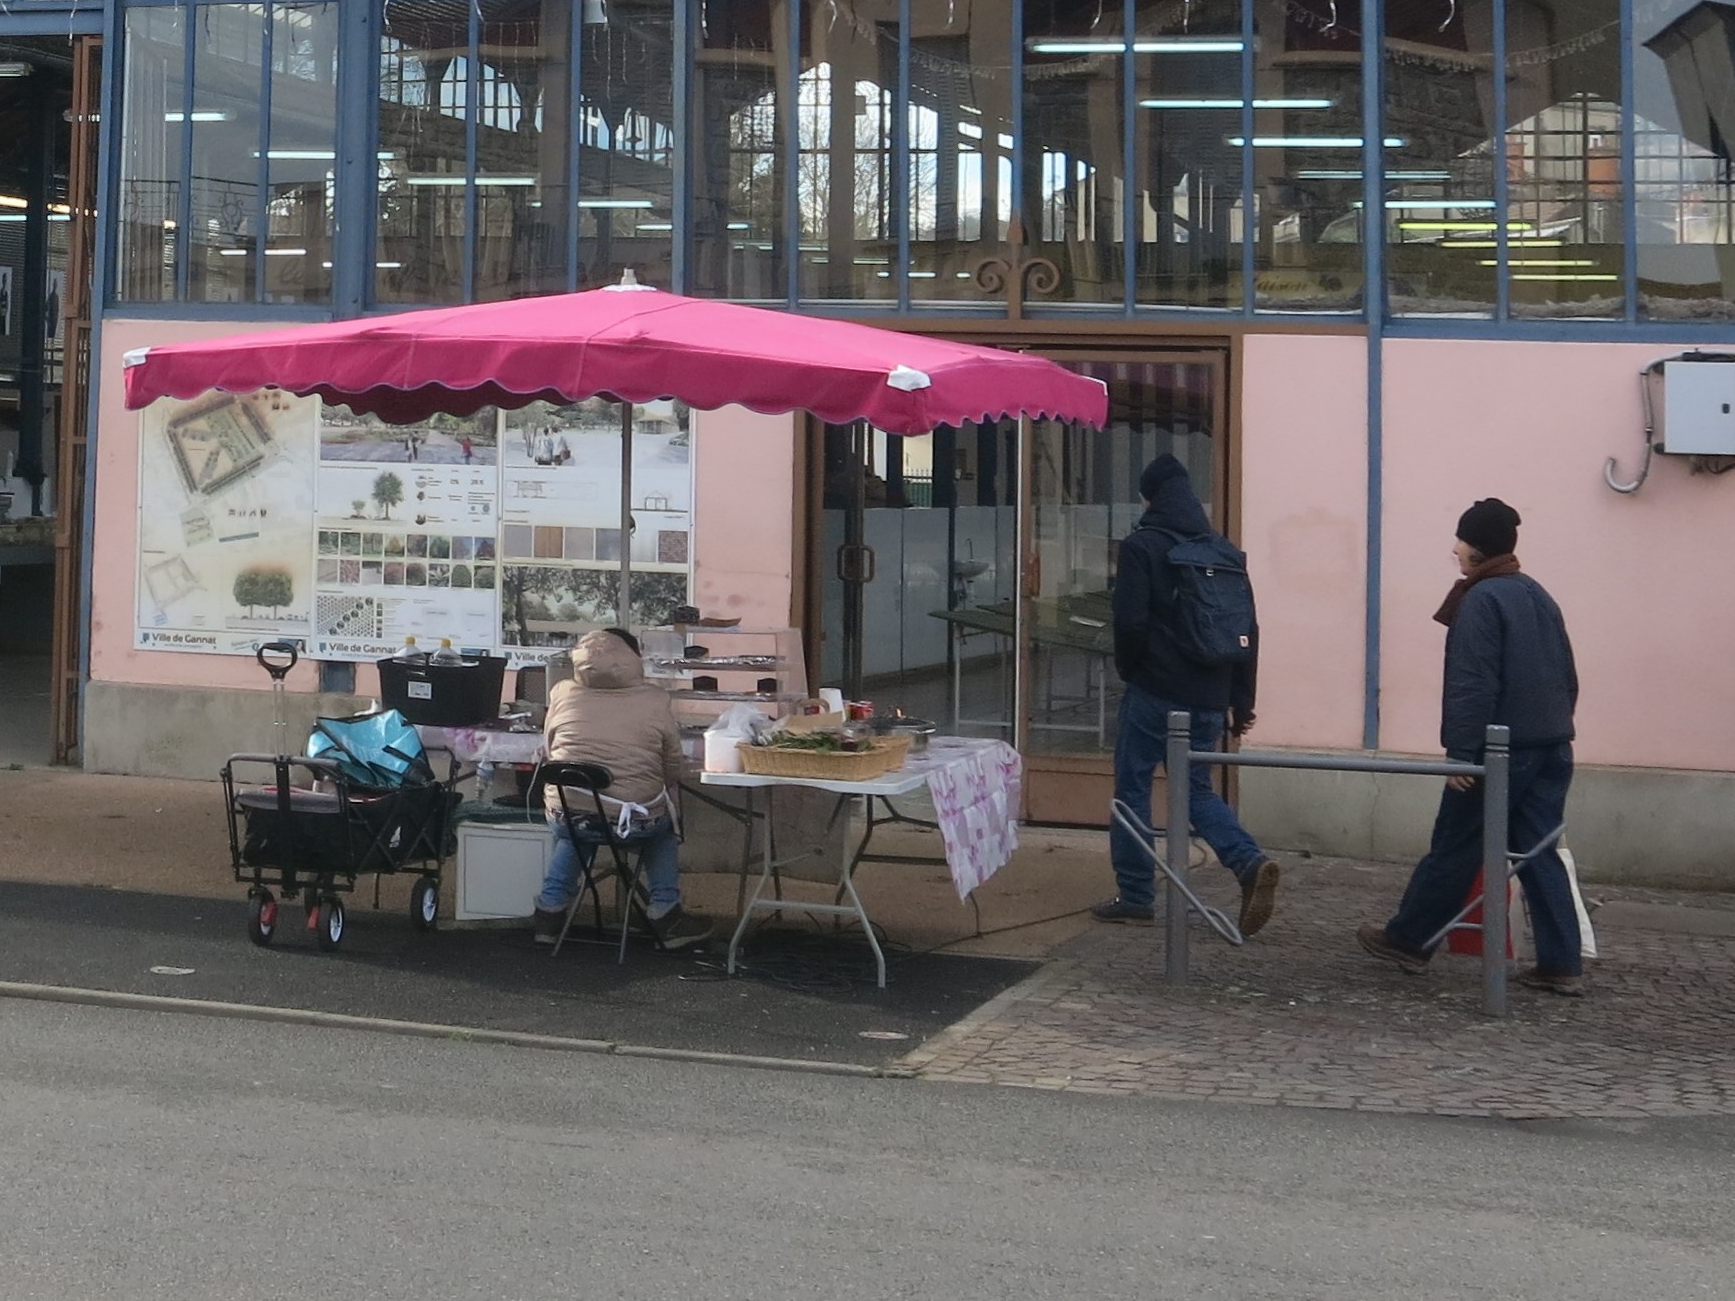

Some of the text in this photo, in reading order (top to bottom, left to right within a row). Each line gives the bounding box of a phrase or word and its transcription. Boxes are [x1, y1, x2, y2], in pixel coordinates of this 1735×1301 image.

[152, 633, 217, 645] Ville de Gannat
[329, 643, 396, 654] Ville de Gannat
[515, 652, 536, 662] Ville
